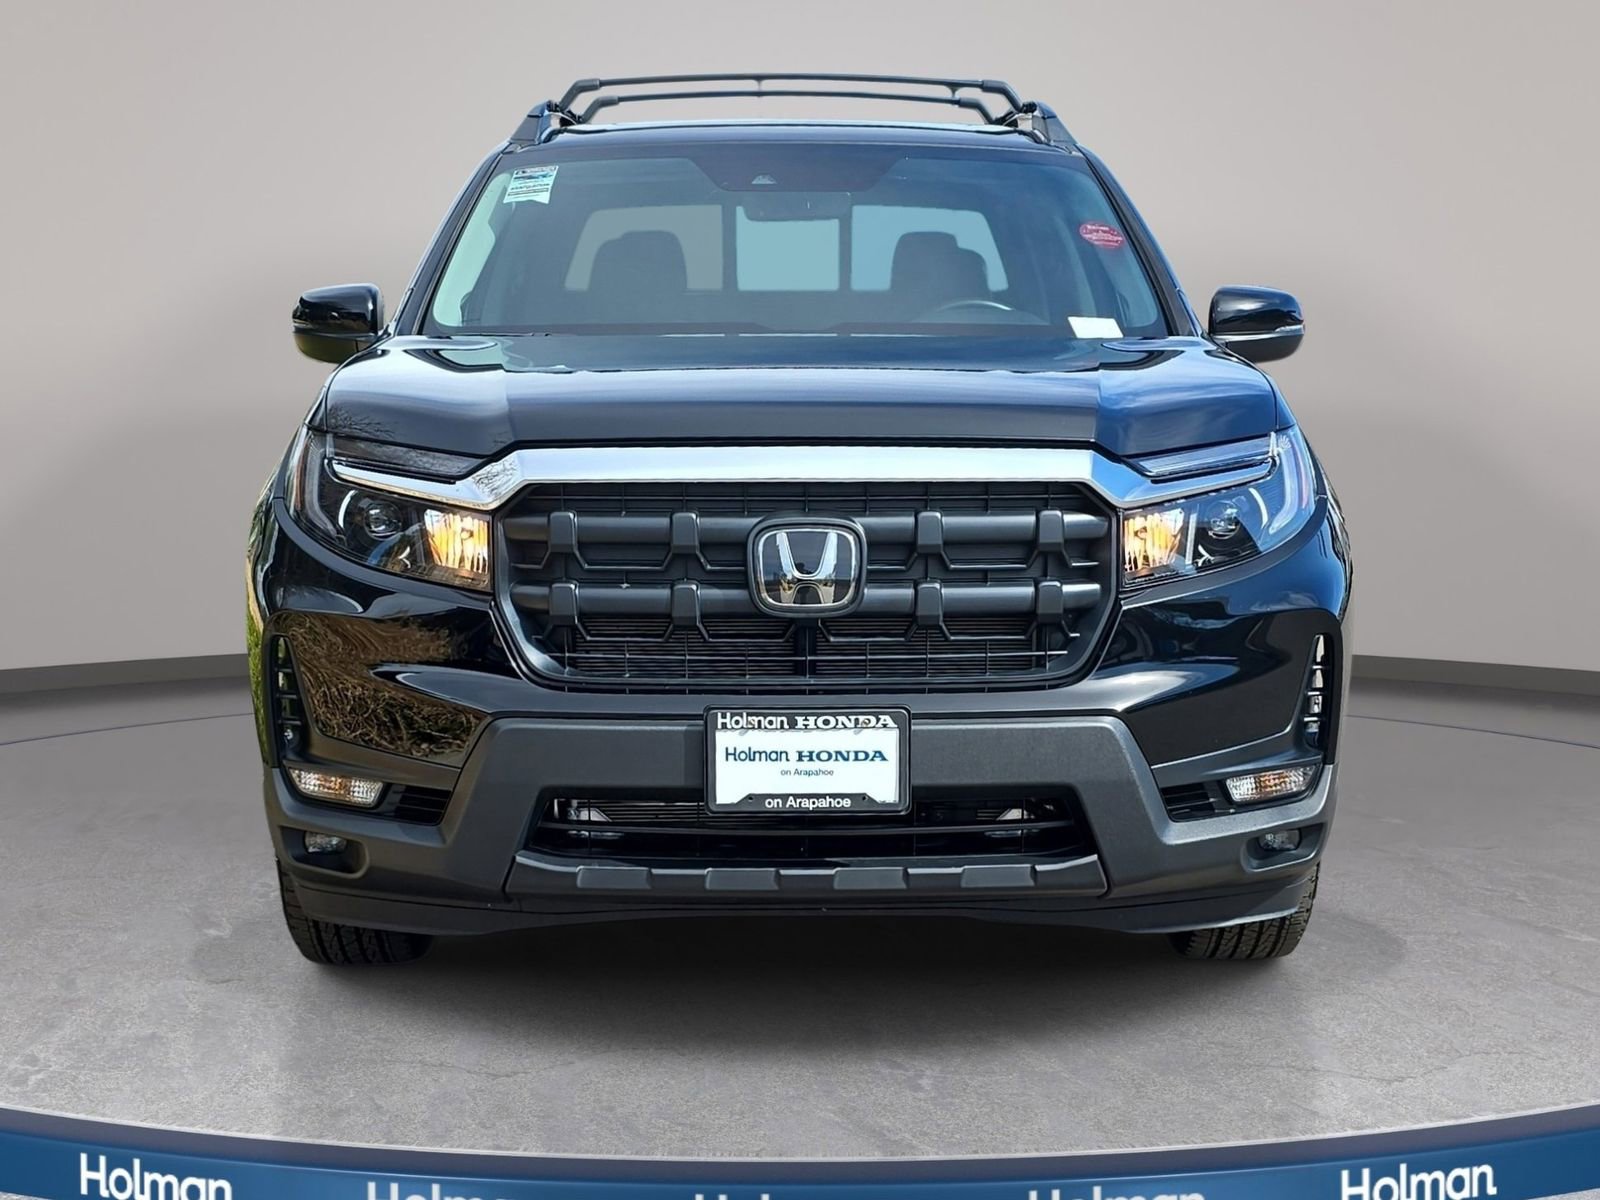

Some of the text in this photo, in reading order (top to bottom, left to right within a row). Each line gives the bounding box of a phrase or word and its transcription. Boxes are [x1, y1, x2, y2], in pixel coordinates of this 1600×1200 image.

[717, 712, 897, 729] Holman HONDA
[725, 747, 888, 762] Holman HONDA
[793, 768, 834, 777] Arapahoe
[765, 796, 851, 810] on Arapahoe
[80, 1152, 232, 1200] Holman
[1341, 1163, 1497, 1200] Holman
